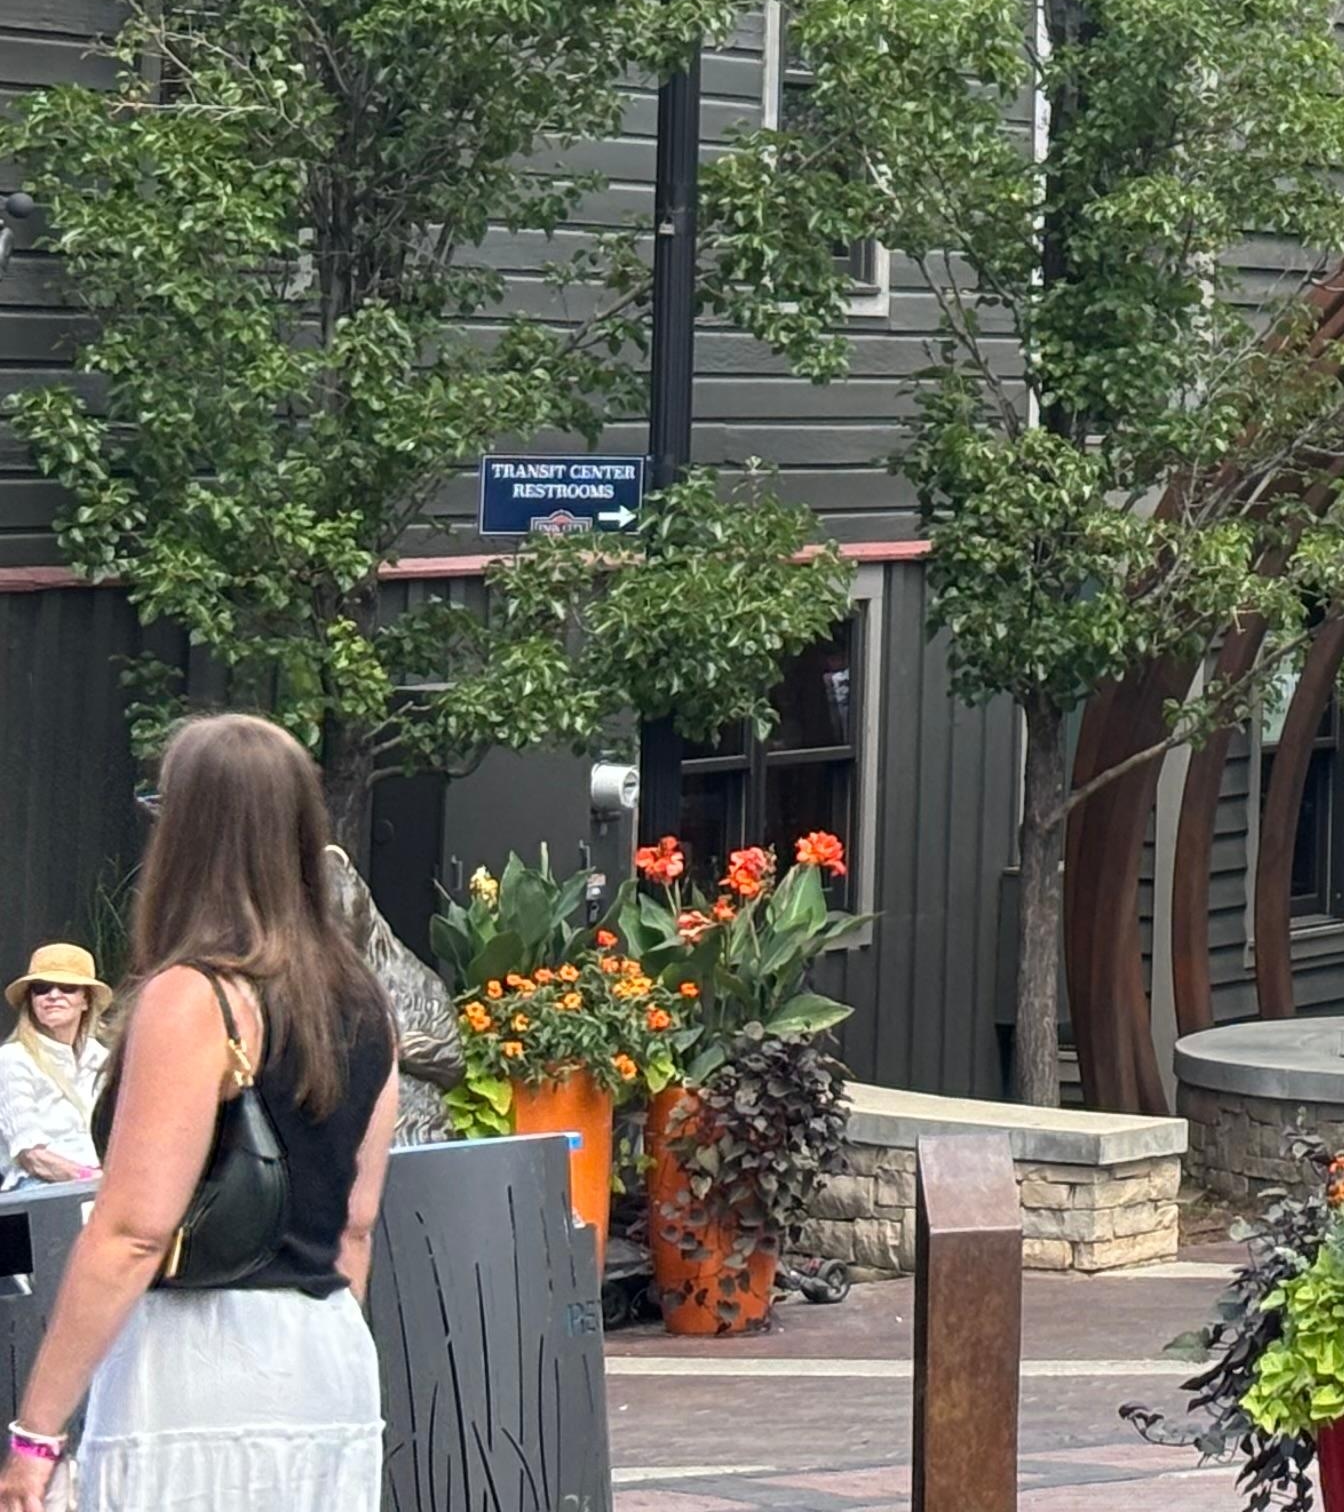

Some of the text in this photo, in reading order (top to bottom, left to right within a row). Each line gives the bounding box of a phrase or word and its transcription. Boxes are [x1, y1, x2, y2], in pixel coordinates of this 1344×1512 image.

[492, 463, 636, 480] TRANSIT CENTER
[512, 483, 614, 499] RESTROOMS
